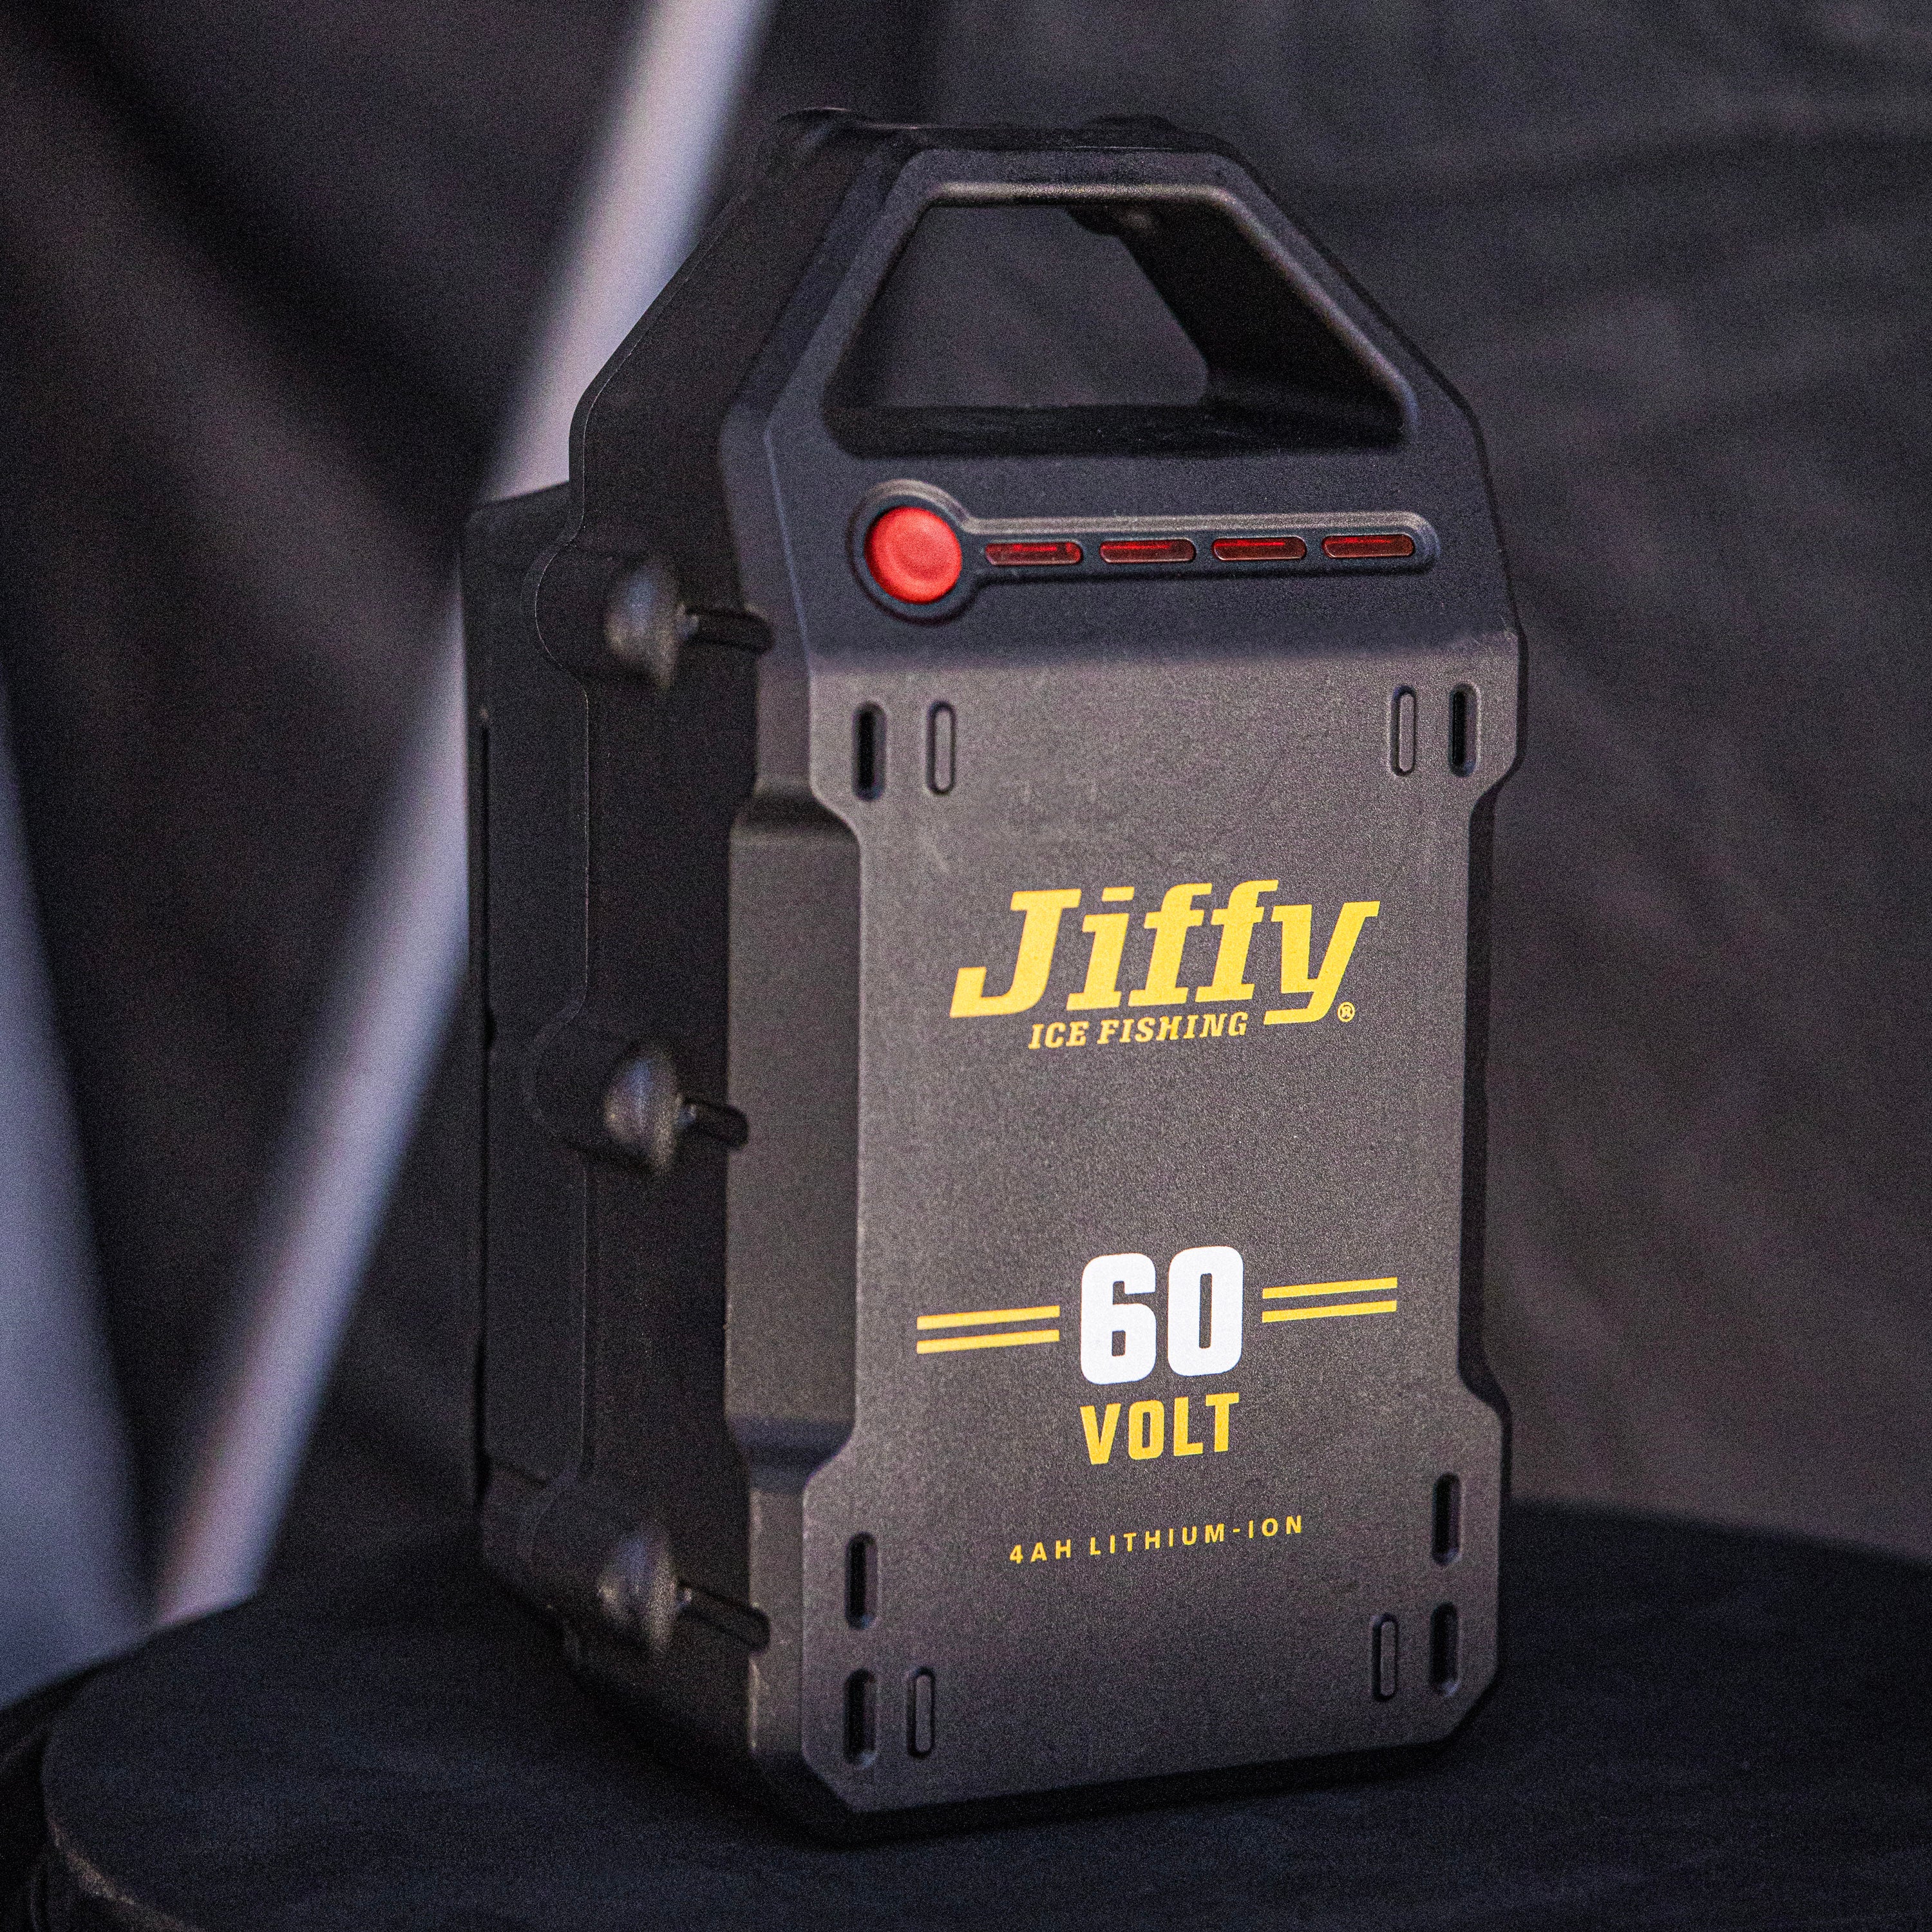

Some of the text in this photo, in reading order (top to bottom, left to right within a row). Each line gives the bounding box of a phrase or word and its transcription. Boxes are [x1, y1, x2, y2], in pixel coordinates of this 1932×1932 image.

[1028, 1010, 1249, 1050] ICE FISHING
[1080, 1245, 1244, 1385] 60
[1079, 1391, 1240, 1465] VOLT
[1009, 1515, 1302, 1564] 4AH LITHIUM-ION
